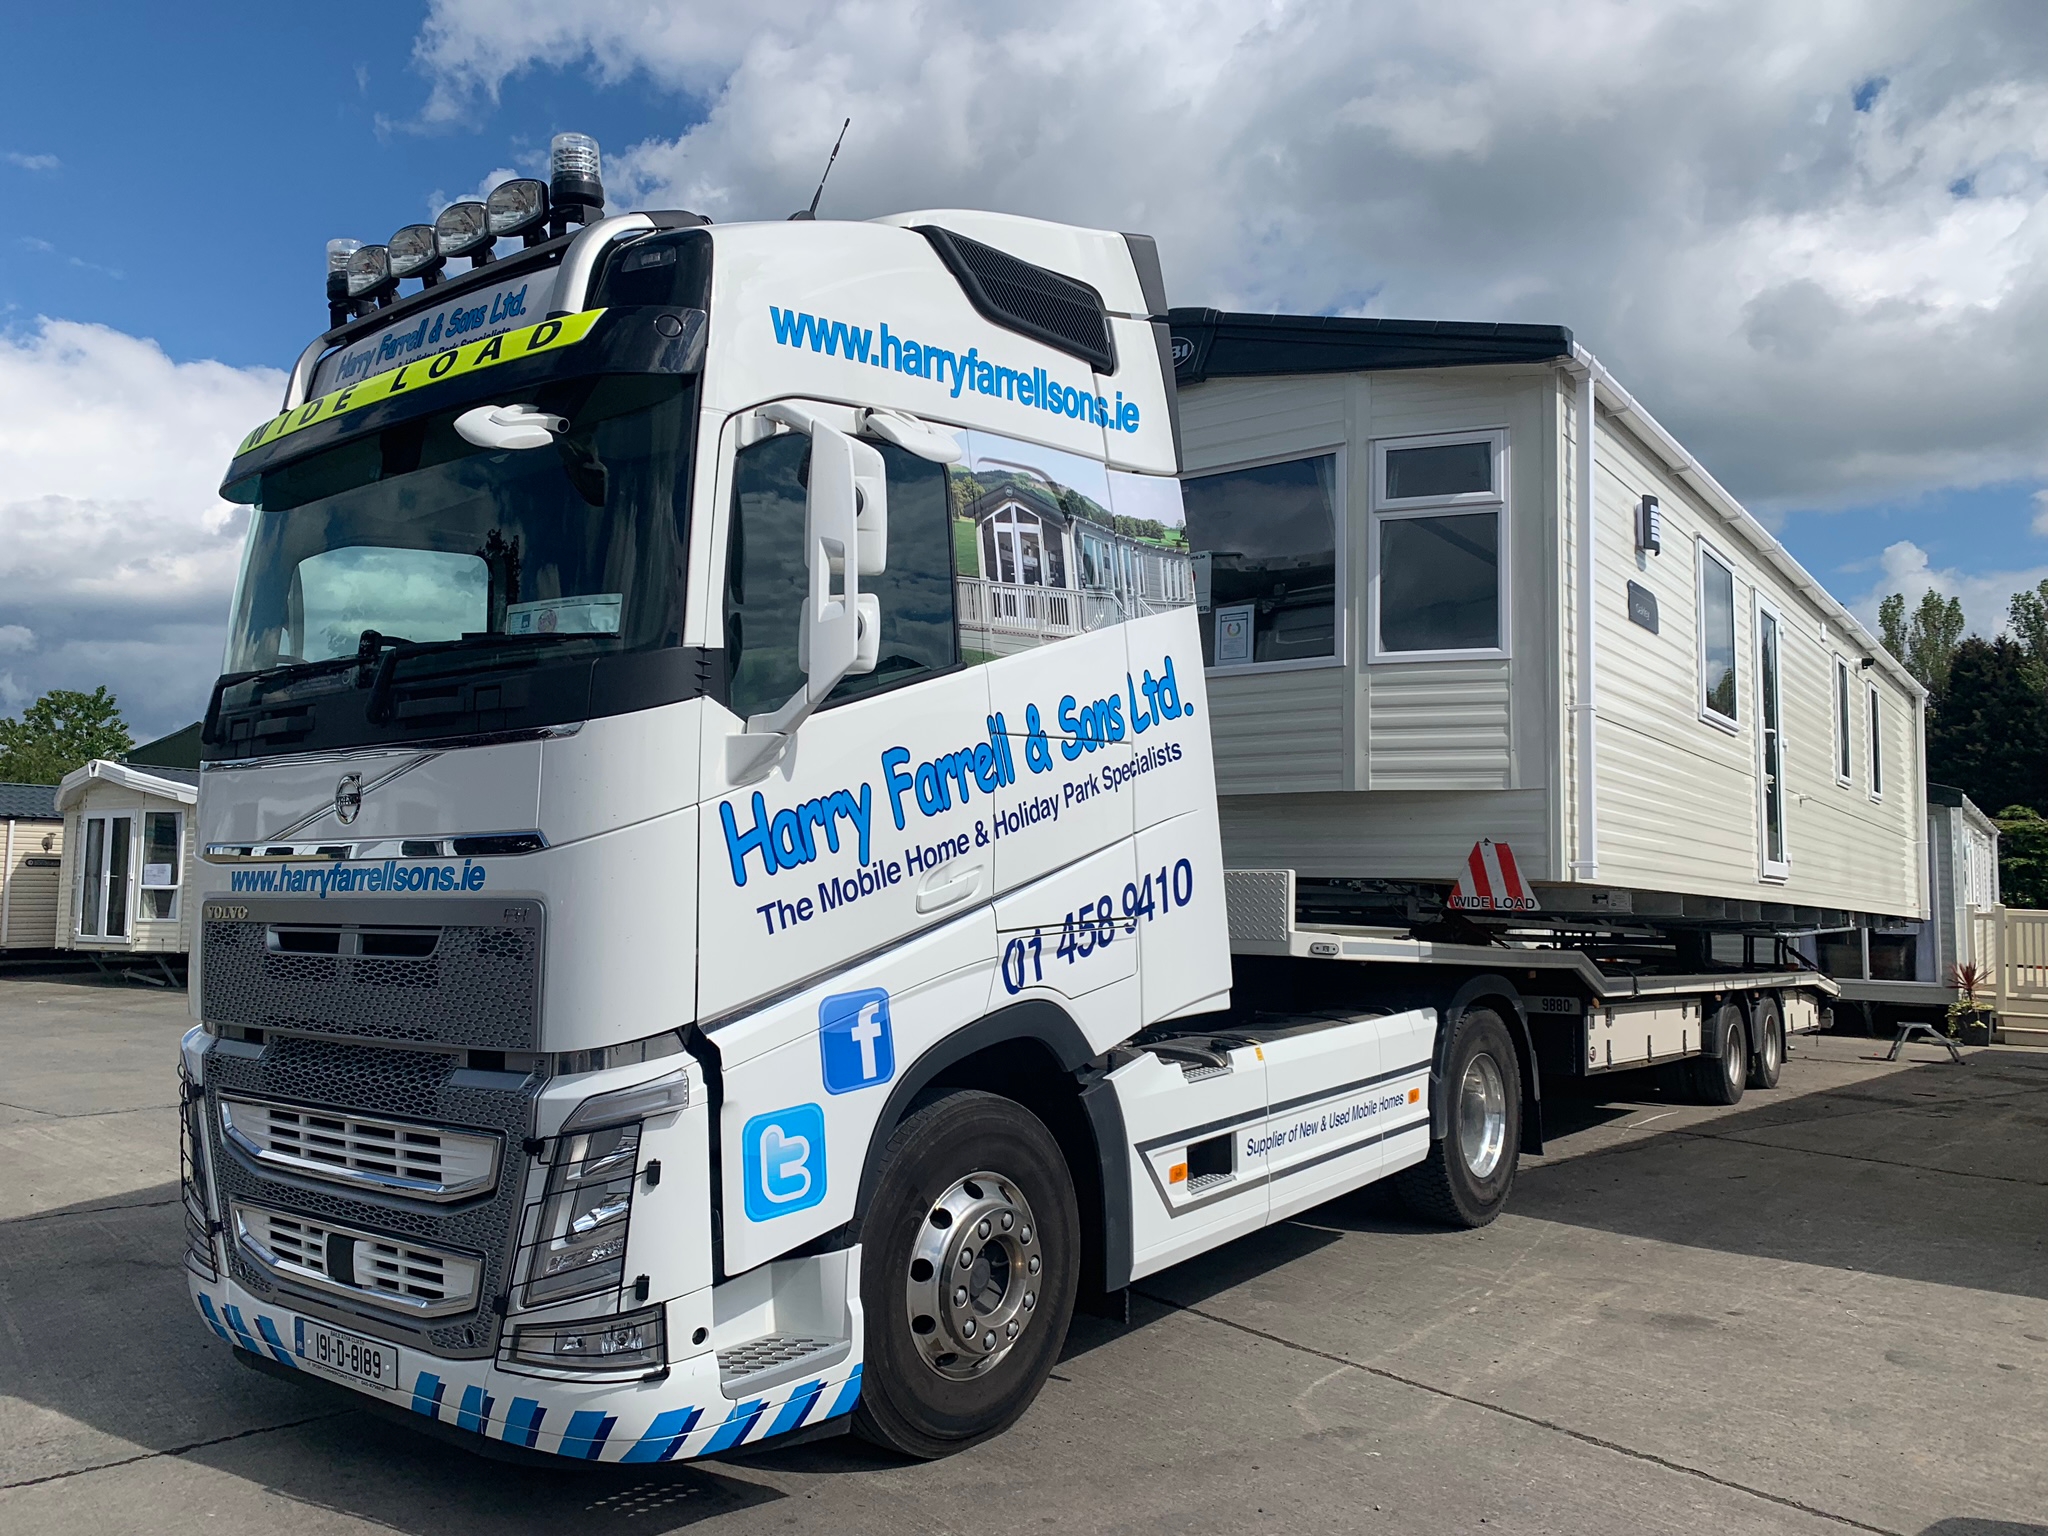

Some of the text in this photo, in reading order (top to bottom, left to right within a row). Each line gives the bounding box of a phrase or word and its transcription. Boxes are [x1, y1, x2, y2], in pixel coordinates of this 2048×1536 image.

[335, 347, 377, 383] Harry
[376, 317, 430, 366] Farrell
[428, 313, 444, 344] &
[445, 304, 488, 338] Sons
[489, 284, 528, 325] Ltd.
[769, 306, 1140, 433] www.harryfarrellsons.ie
[247, 383, 359, 449] WIDE
[389, 320, 563, 393] LOAD
[719, 655, 1195, 888] Harry Farrell & Sons Ltd.
[230, 859, 486, 899] www.harryfarrellsons.ie
[756, 741, 1183, 936] The Mobile Home & Holiday Park Specialists
[206, 905, 248, 920] VOLVO
[1001, 857, 1193, 995] 01 458 9410
[1453, 896, 1535, 909] WIDE LOAD
[1246, 1093, 1404, 1158] Supplier of New & Used Mobile Homes
[316, 1332, 381, 1379] 191-D-8189
